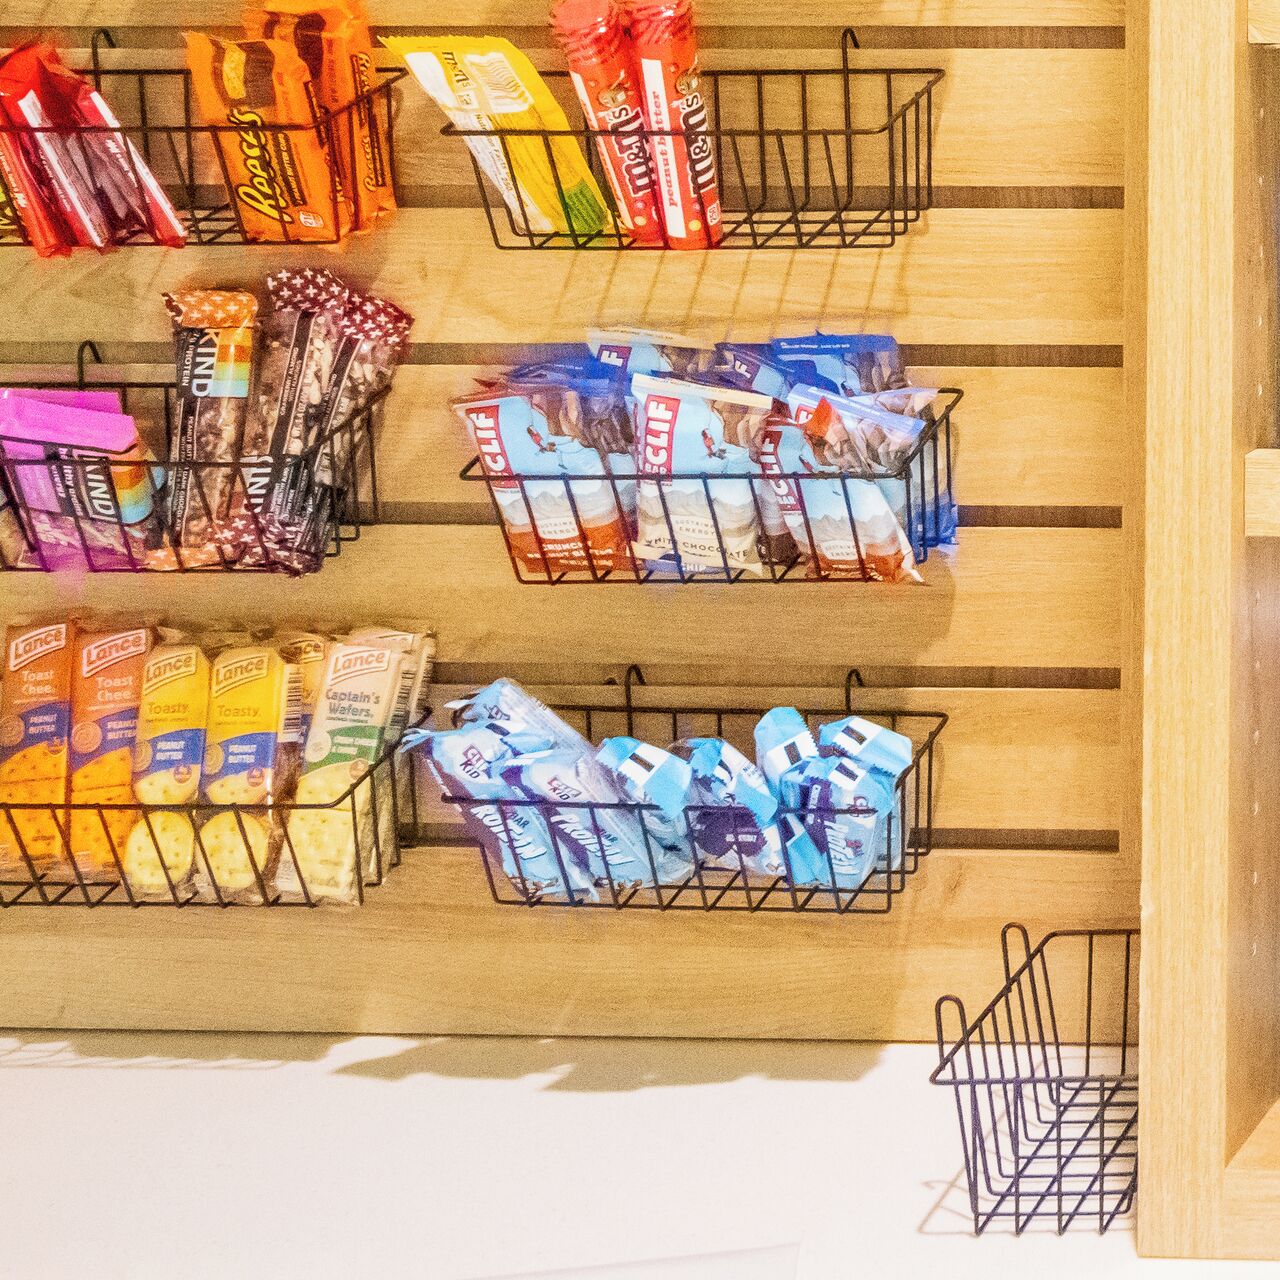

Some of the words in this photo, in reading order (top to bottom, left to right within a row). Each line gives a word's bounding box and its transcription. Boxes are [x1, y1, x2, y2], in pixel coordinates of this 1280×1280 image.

[659, 148, 679, 207] peanut
[191, 327, 220, 398] KIND
[469, 408, 507, 472] CLIF
[644, 399, 677, 468] CLIF
[145, 655, 193, 683] Lance
[215, 658, 266, 684] Lance
[333, 650, 386, 674] Lance
[96, 676, 134, 688] Toast
[325, 688, 381, 705] Captain's
[218, 705, 260, 719] Toasty
[329, 703, 371, 719] Wafers
